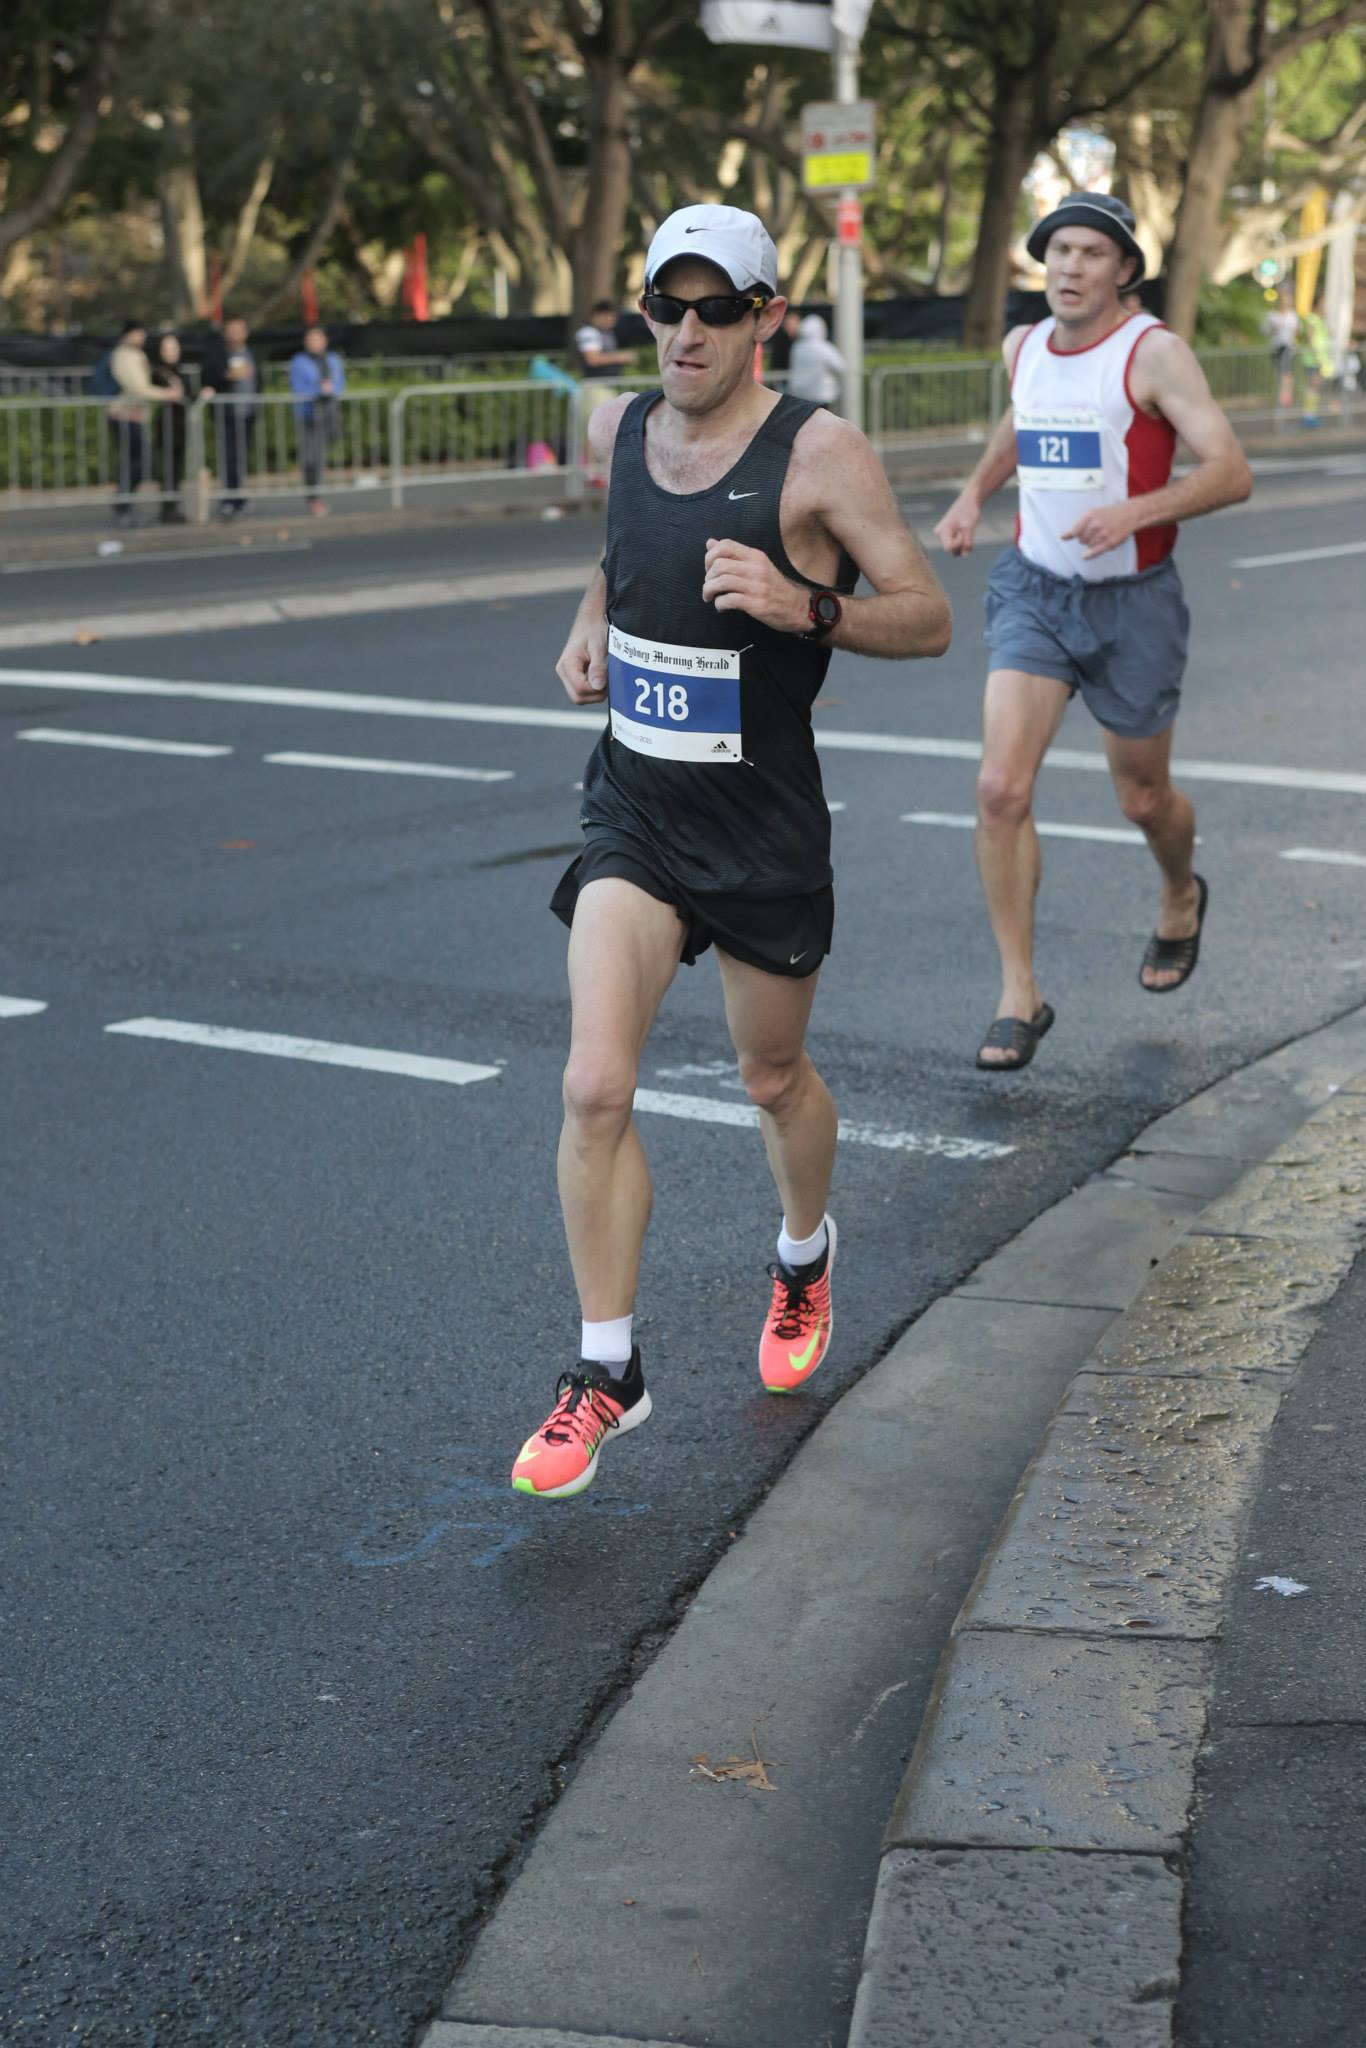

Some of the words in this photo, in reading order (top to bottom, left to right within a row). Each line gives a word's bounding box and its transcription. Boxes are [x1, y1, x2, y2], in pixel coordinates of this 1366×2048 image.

[1038, 436, 1069, 463] 121
[612, 635, 622, 650] The
[623, 642, 650, 662] Sydney
[652, 650, 693, 670] Morning
[695, 656, 729, 671] Herald
[634, 678, 689, 721] 218
